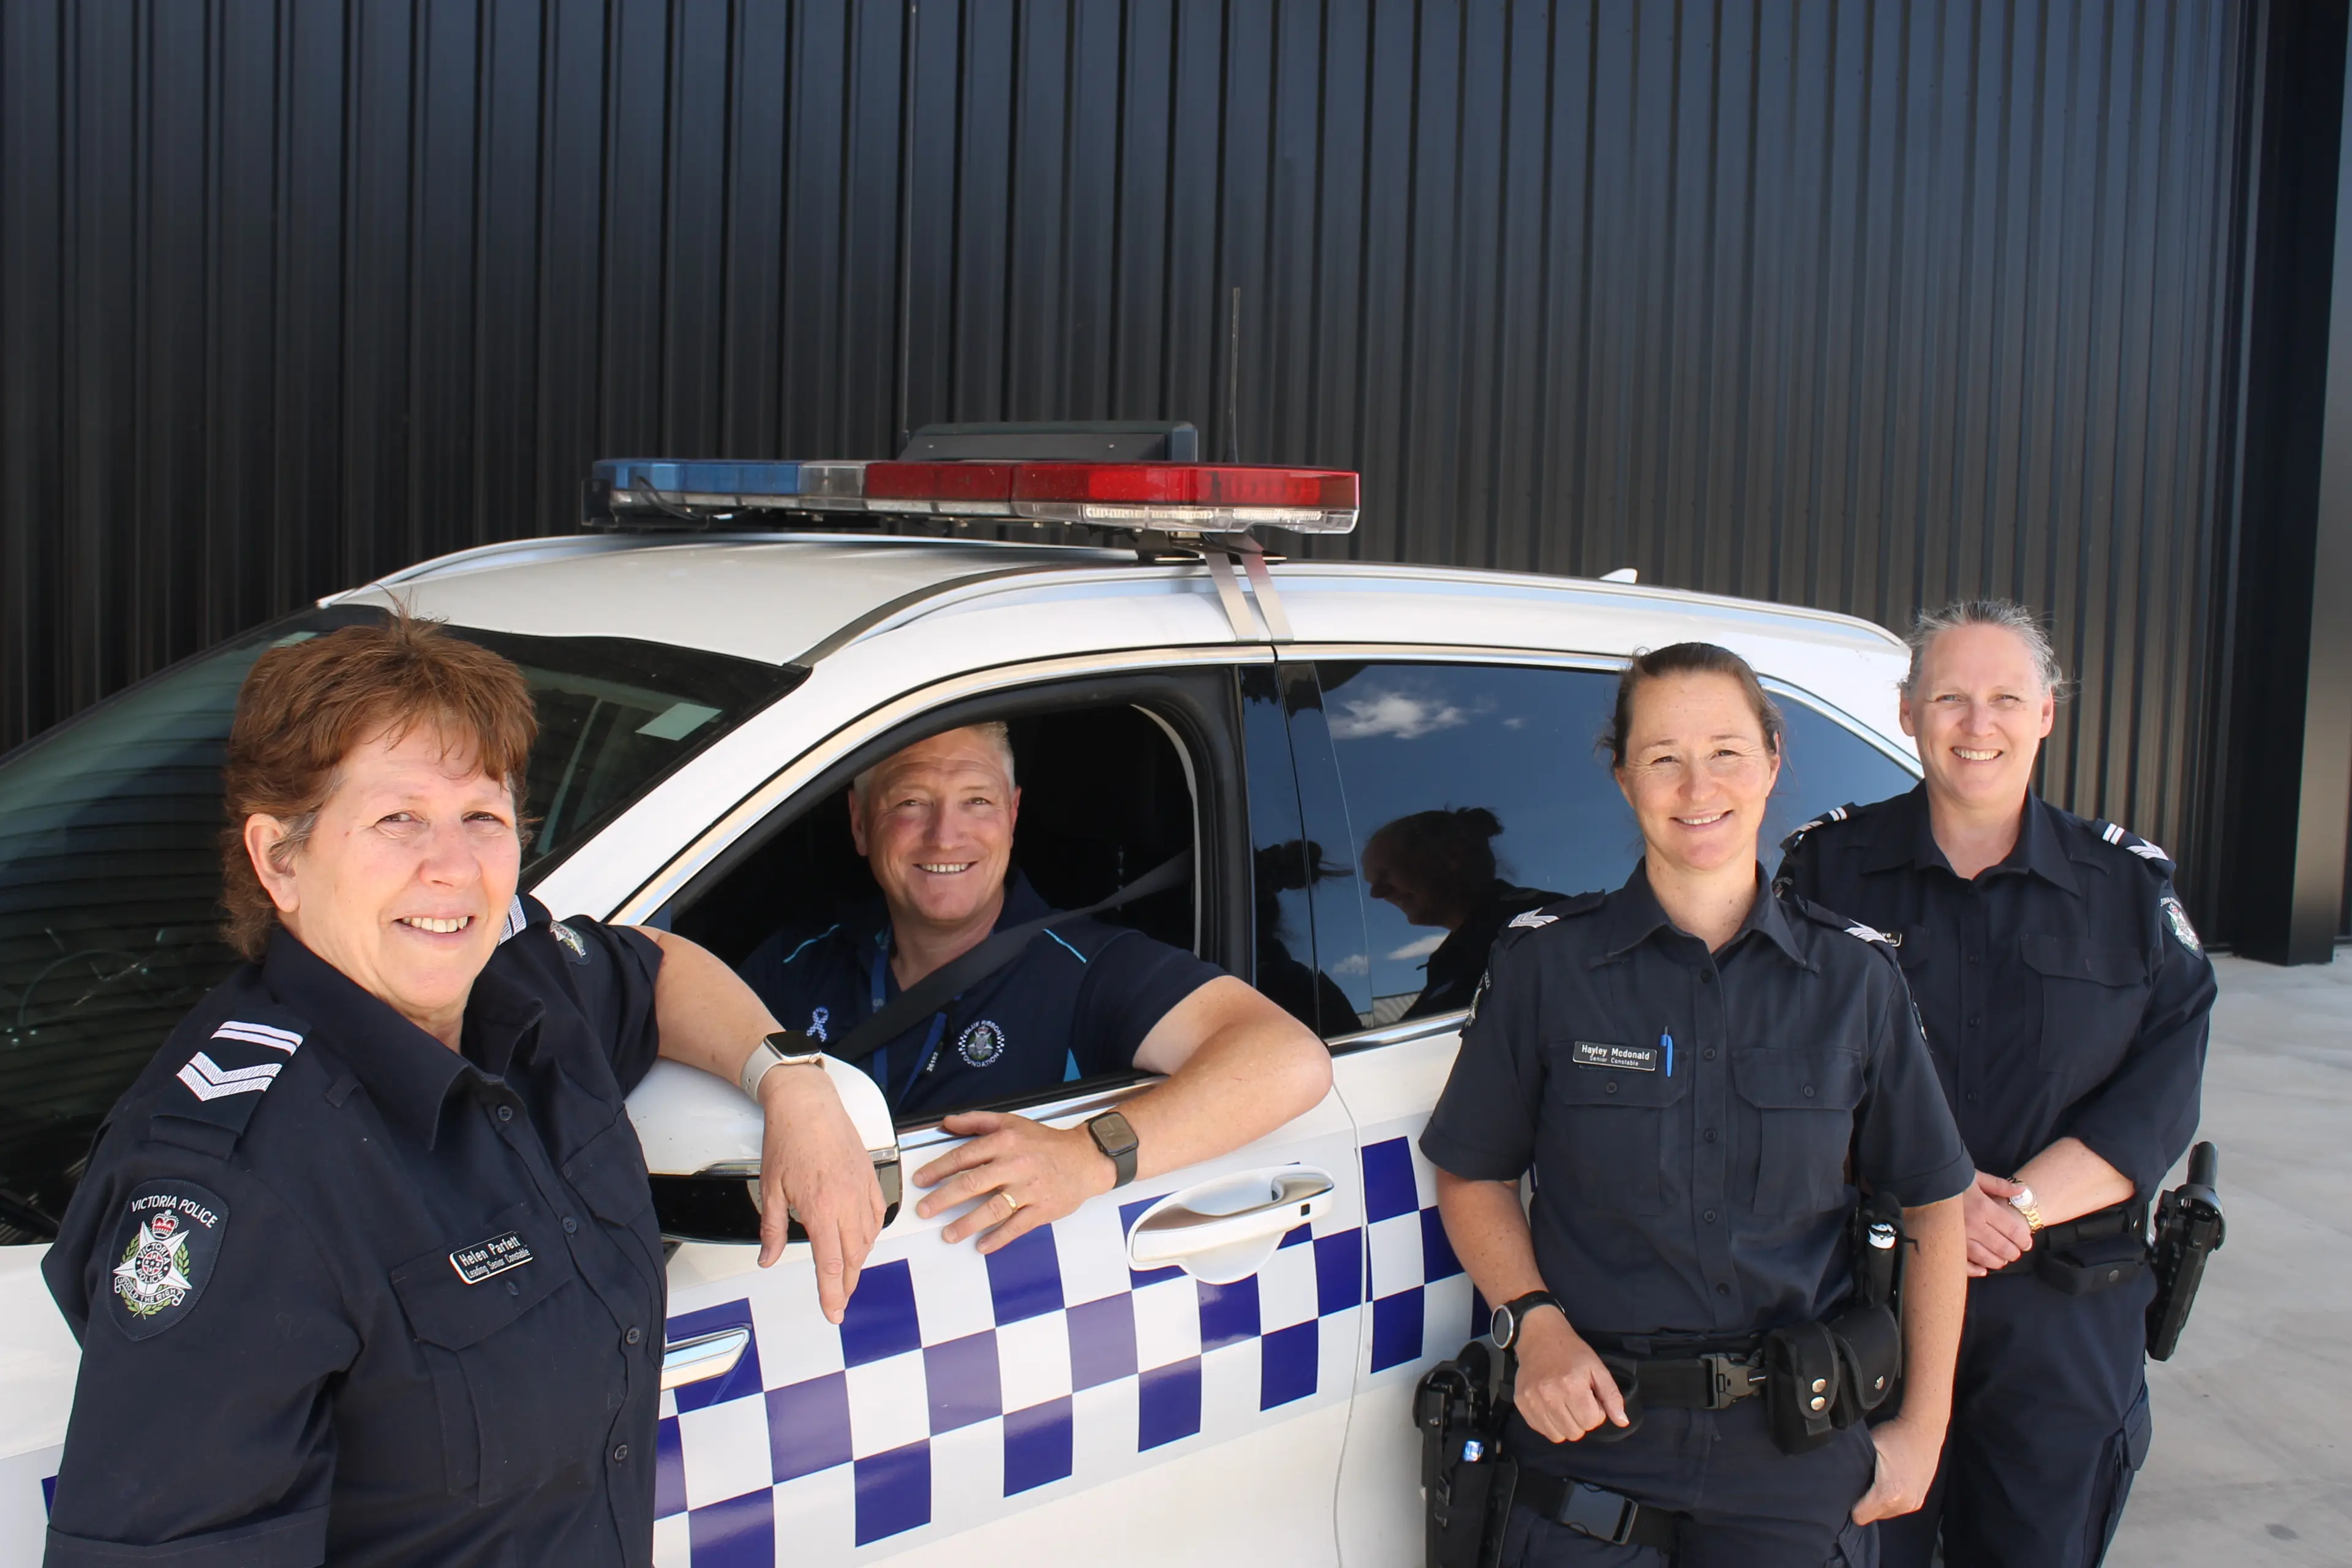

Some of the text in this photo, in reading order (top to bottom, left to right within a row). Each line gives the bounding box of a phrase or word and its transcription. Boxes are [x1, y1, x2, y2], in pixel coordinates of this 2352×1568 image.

[981, 1020, 1002, 1036] RIBBON
[961, 1051, 1000, 1068] FOUNDATION
[1581, 1044, 1650, 1061] Hayley Mcdonald
[1610, 1057, 1639, 1067] Constable
[132, 1195, 218, 1229] VICTORIA POLICE
[137, 1243, 172, 1265] VICTORIA
[458, 1236, 521, 1267] Helen Parfett
[465, 1247, 530, 1279] Leading Senior Constable
[137, 1268, 164, 1283] POLICE
[117, 1278, 138, 1299] UPHOLD
[156, 1289, 181, 1302] RIGHT
